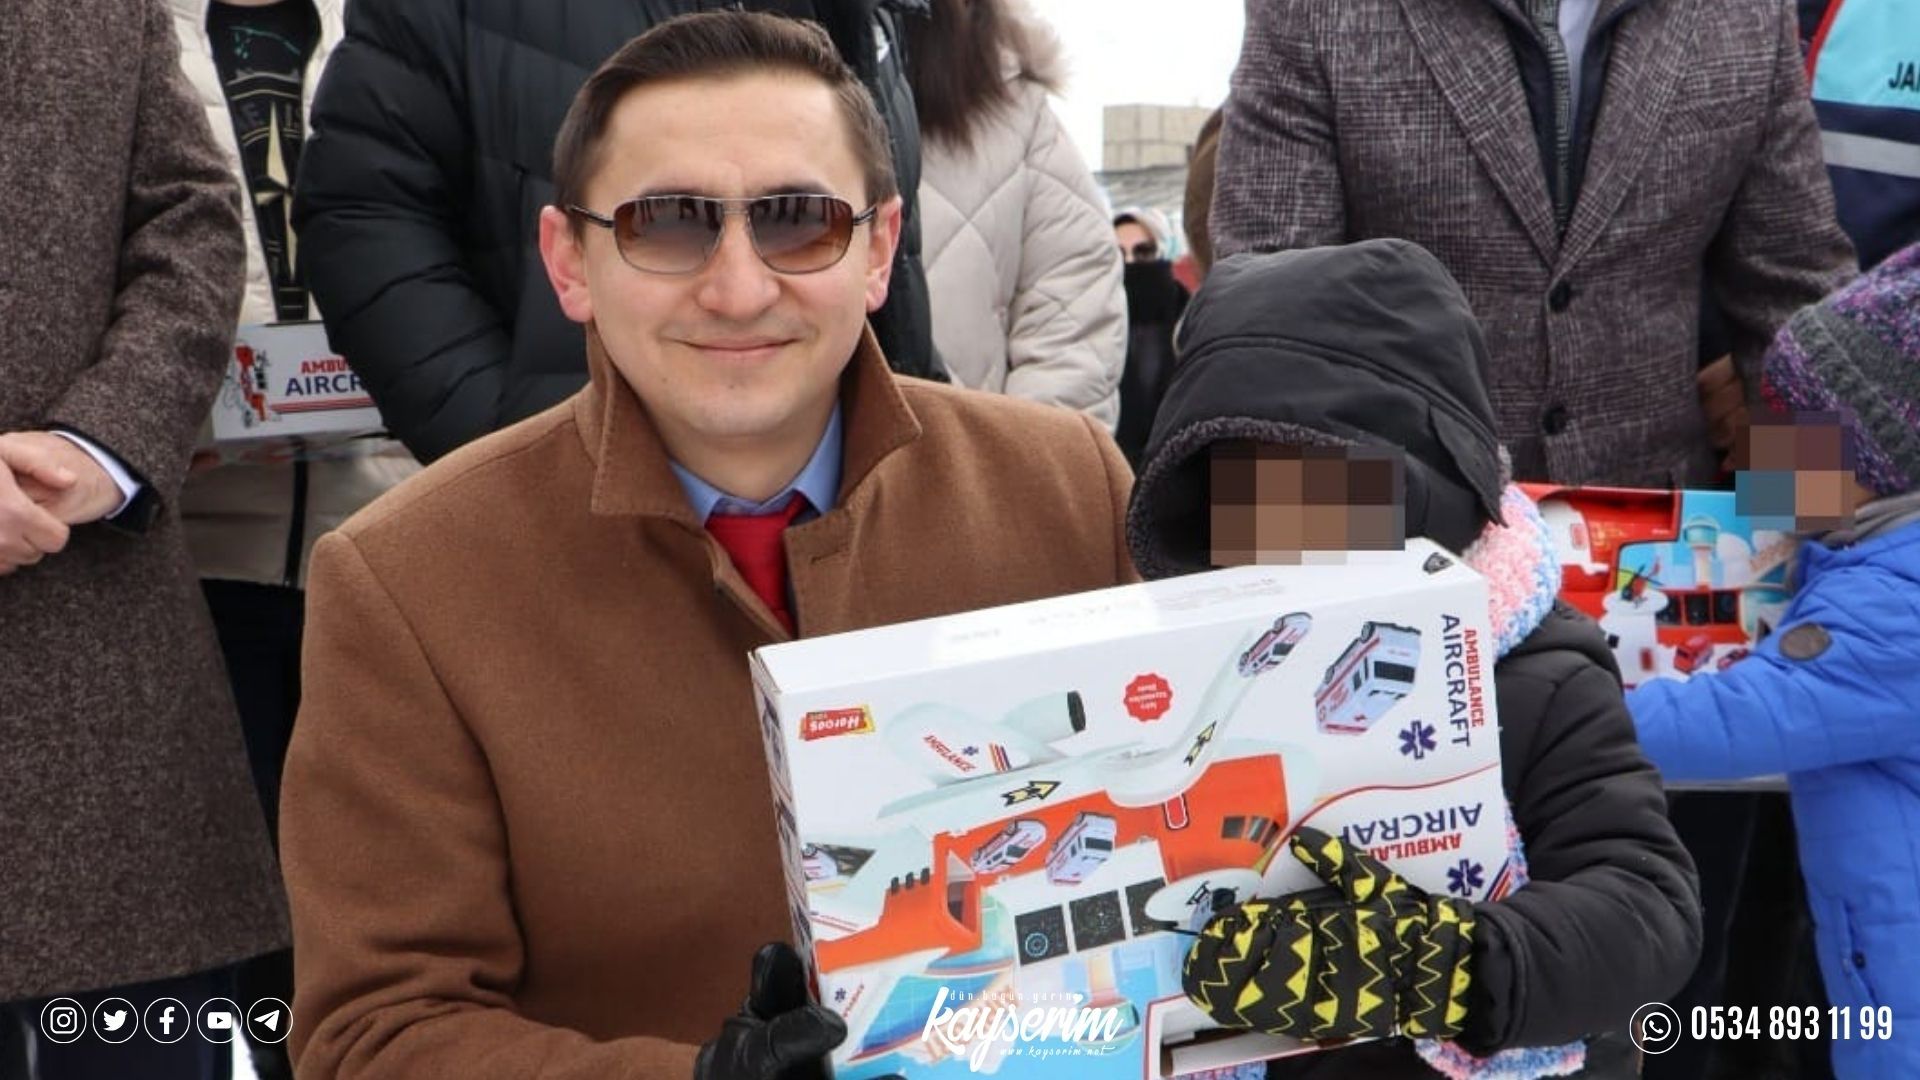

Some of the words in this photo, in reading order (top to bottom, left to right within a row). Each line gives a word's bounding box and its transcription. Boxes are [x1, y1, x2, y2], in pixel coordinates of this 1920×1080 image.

[1888, 61, 1920, 92] JA
[1441, 613, 1471, 747] AIRCRAFT
[1464, 628, 1485, 728] AMBULANCE
